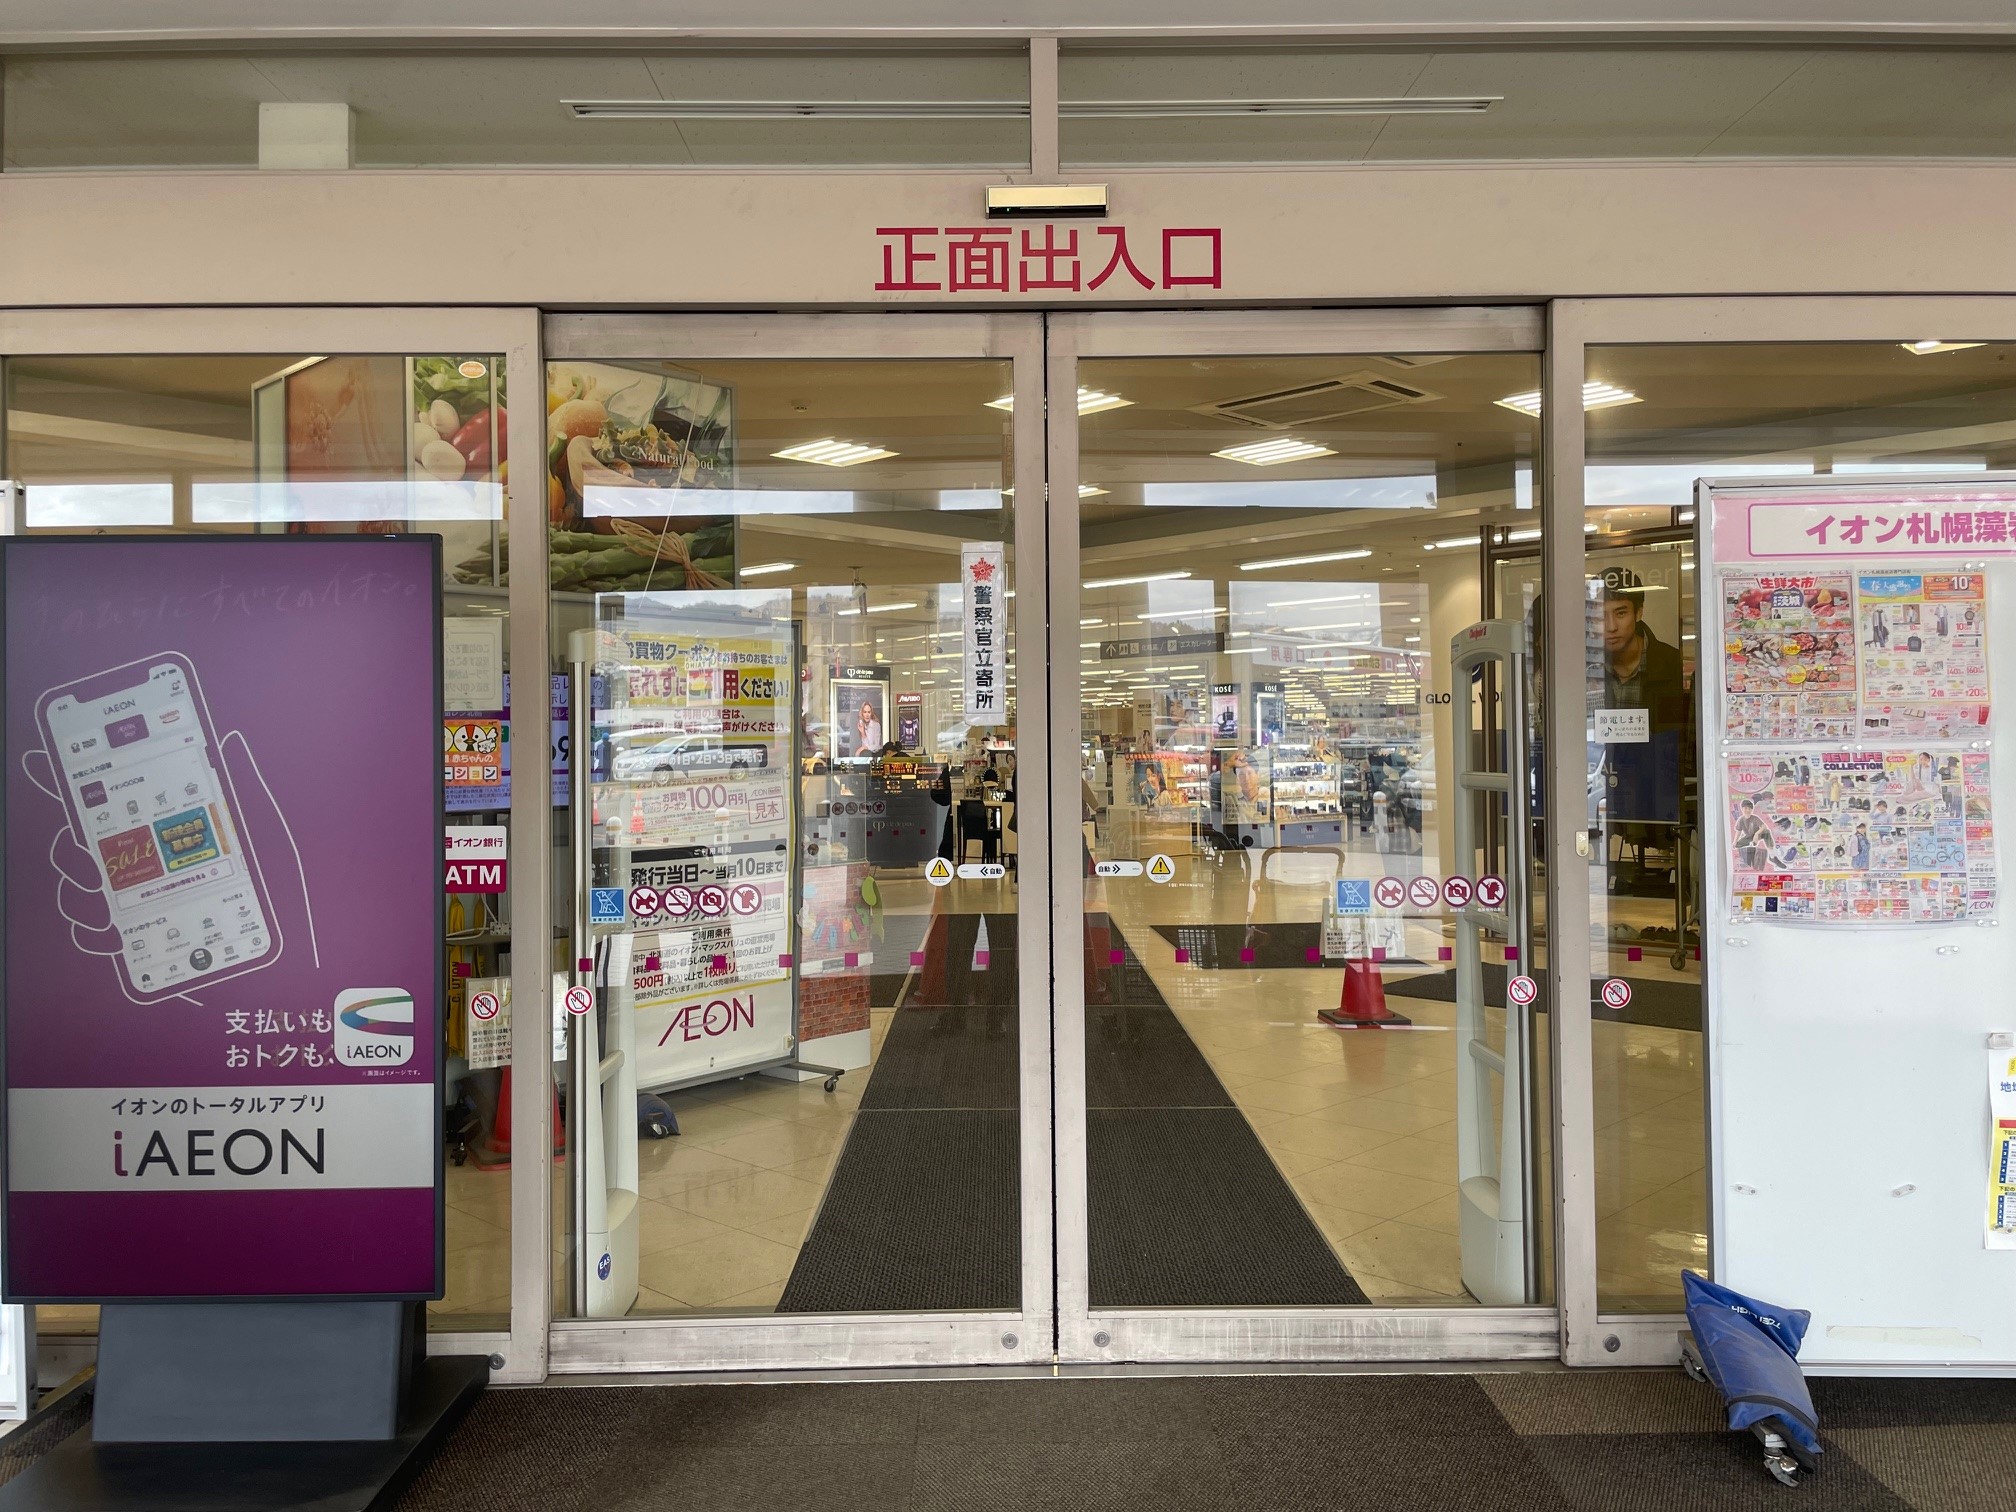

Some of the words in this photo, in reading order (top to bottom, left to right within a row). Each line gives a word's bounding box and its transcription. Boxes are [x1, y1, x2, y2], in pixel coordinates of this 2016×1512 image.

[874, 224, 1222, 293] 正面出入口
[638, 447, 683, 467] Natural
[686, 454, 714, 471] ood
[1805, 511, 2016, 545] イオン札幌藻
[1760, 577, 1815, 588] 生鮮大市
[973, 585, 995, 709] 警察官立寄所
[1180, 640, 1217, 648] エスカレーター
[1214, 685, 1232, 693] KOSÉ
[1265, 684, 1278, 692] KOSÉ
[1600, 715, 1646, 725] 節電します。
[452, 754, 494, 763] 赤ちゃんの
[1822, 753, 1851, 763] NEW
[1853, 753, 1883, 763] LIFE
[1823, 762, 1883, 771] COLLECTION
[686, 784, 727, 811] 100
[756, 801, 780, 820] 見本
[454, 837, 504, 849] イオン銀行
[105, 837, 155, 878] SALE
[446, 863, 501, 885] ATM
[990, 867, 1003, 875] 自動
[1098, 865, 1111, 873] 自動
[451, 961, 461, 1003] CUTION
[225, 1009, 332, 1034] 支払いも
[347, 1045, 401, 1059] iAEON
[112, 1095, 326, 1116] イオンのトータルアプリ
[114, 1128, 325, 1177] iAEON
